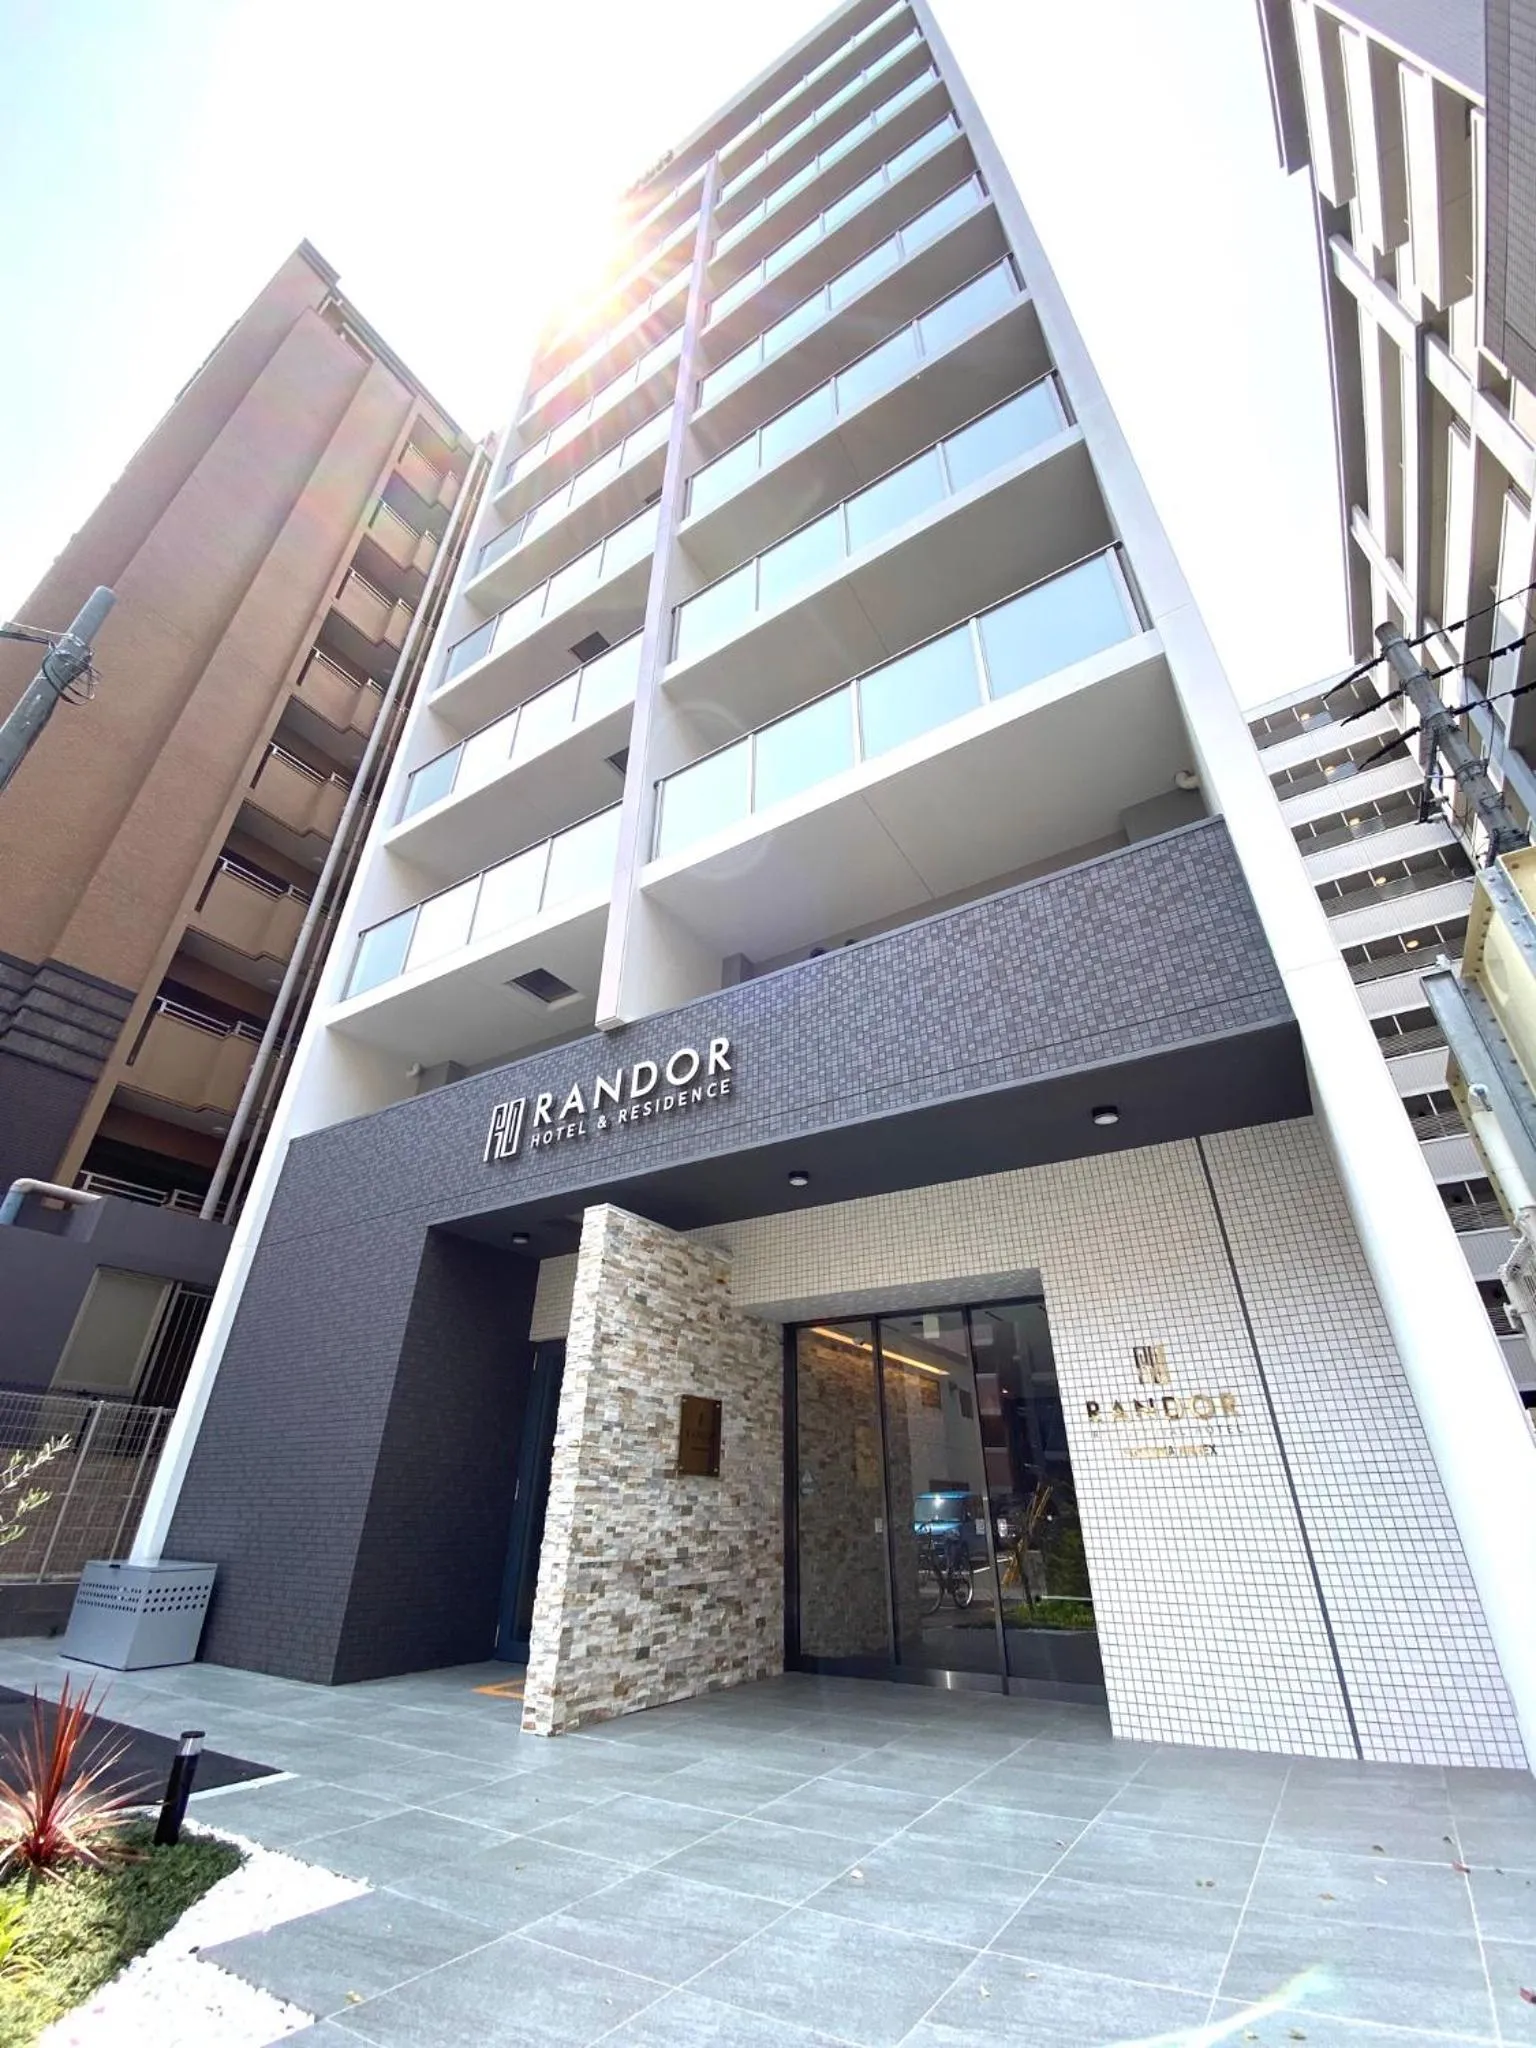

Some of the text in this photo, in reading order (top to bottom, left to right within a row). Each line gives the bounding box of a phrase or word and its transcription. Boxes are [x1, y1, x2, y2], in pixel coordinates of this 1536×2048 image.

[530, 1078, 732, 1148] HOTEL & RESIDENCE
[533, 1037, 732, 1127] RANDOR
[1086, 1392, 1238, 1423] RANDOR
